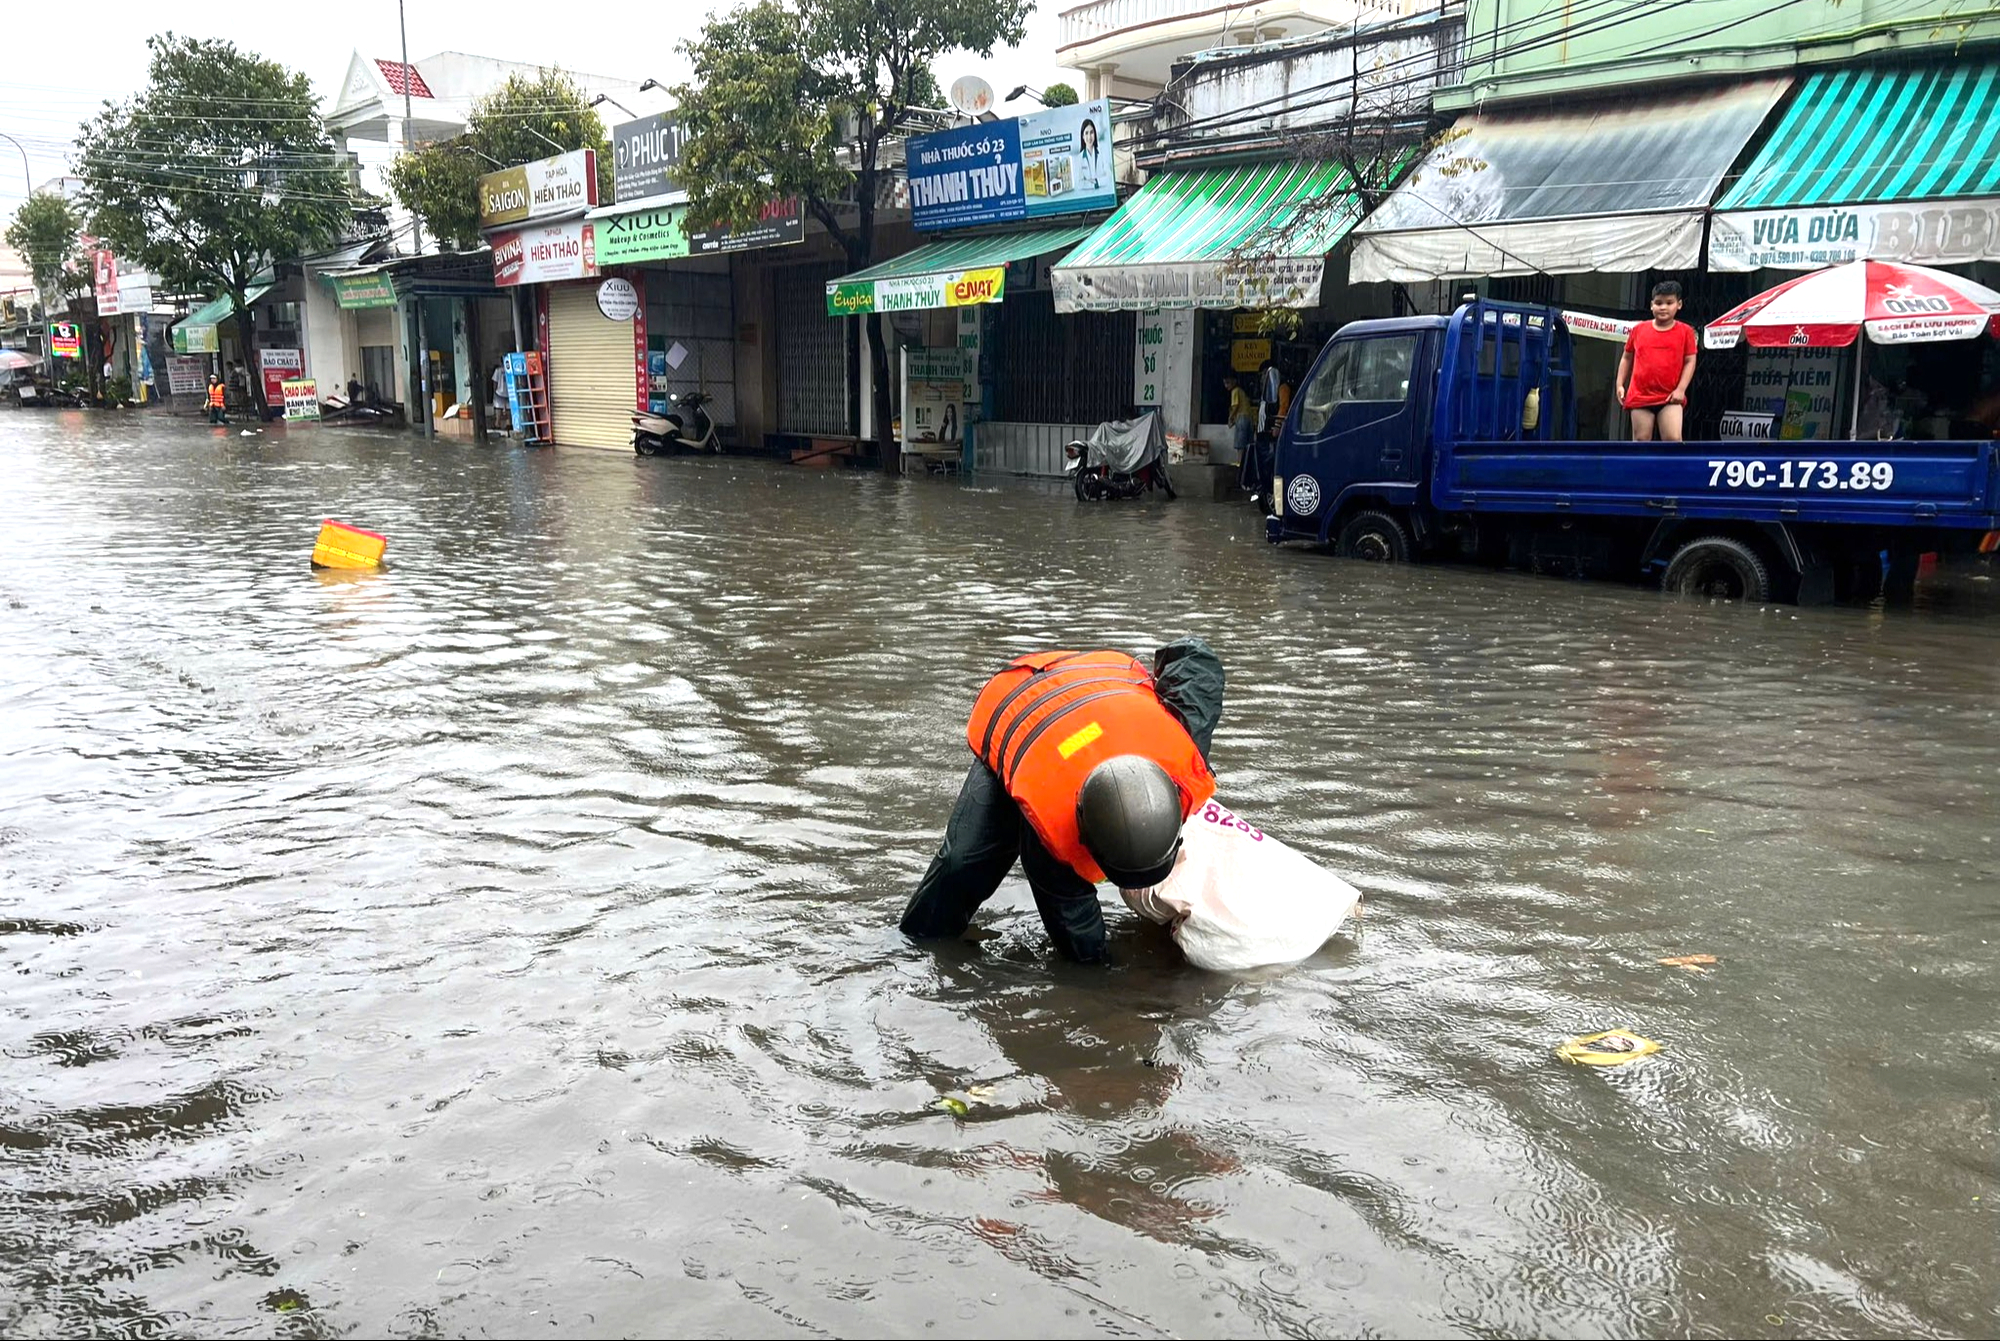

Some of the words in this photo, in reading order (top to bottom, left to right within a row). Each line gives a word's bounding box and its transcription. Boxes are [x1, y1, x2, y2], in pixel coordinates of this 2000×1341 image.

[631, 121, 669, 168] PHÚC
[921, 148, 941, 165] NHÀ
[941, 140, 974, 162] THUỐC
[976, 136, 990, 155] SỐ
[992, 138, 1005, 153] 23
[556, 178, 581, 199] THẢO
[909, 171, 969, 207] THANH
[969, 153, 1018, 200] THỦY
[489, 187, 526, 213] SAIGON
[609, 235, 631, 245] Makeup
[632, 234, 637, 242] &
[638, 230, 670, 241] Cosmetics
[1753, 214, 1799, 250] VỰA
[1808, 209, 1859, 243] DỪA
[494, 239, 522, 266] BIVINA
[552, 235, 579, 259] THẢO
[1141, 267, 1189, 298] XUÂN
[833, 290, 874, 311] Eugica
[882, 292, 913, 310] THANH
[914, 285, 941, 308] THỦY
[1885, 297, 1950, 314] OMO
[1138, 322, 1163, 344] THUỐC
[1789, 335, 1808, 344] OMO
[909, 364, 938, 376] THANH
[1144, 351, 1156, 374] SỐ
[1144, 384, 1154, 401] 23
[1721, 416, 1744, 437] DỪA
[1748, 422, 1770, 439] 10K
[1708, 461, 1894, 491] 79C-173.89
